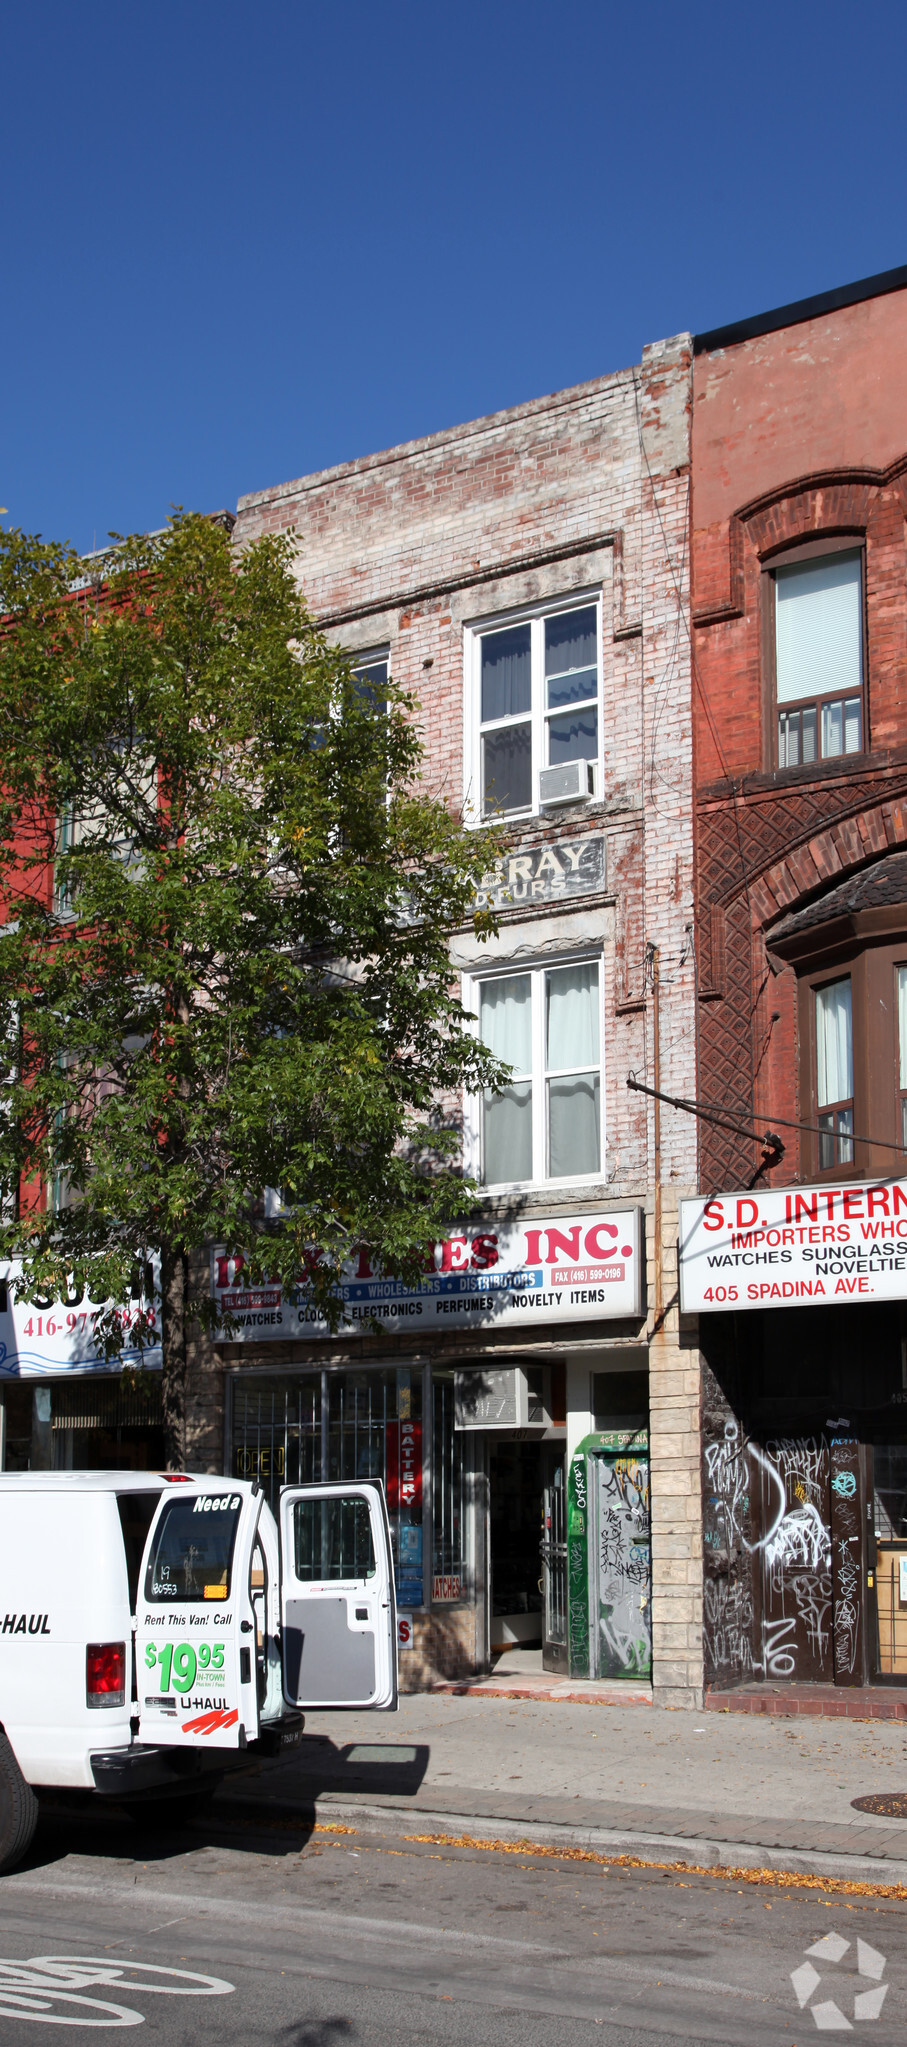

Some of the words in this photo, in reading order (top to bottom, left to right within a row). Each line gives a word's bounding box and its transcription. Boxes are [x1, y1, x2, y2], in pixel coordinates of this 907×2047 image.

[498, 879, 566, 903] FURS
[703, 1199, 768, 1231] S.D.
[524, 1223, 633, 1266] INC.
[731, 1224, 851, 1249] IMPORTERS
[860, 1219, 907, 1240] WHO
[707, 1250, 792, 1268] WATCHES
[802, 1241, 907, 1261] SUNGLASS
[816, 1257, 906, 1275] NOVELTIE
[368, 1280, 441, 1298] WHOLESALERS
[460, 1272, 536, 1291] DISTRIBUTORS
[555, 1272, 569, 1283] FAX
[570, 1269, 588, 1284] (416)
[590, 1267, 621, 1281] 599-0196
[703, 1285, 739, 1302] 405
[747, 1279, 826, 1300] SPADINA
[834, 1276, 875, 1295] AVE.
[238, 1312, 283, 1327] WATCHES
[352, 1302, 423, 1319] ELECTRONICS
[436, 1297, 494, 1314] PERFUMES
[512, 1292, 563, 1308] NOVELTY
[571, 1289, 605, 1304] ITEMS
[240, 1450, 281, 1473] OPEN
[402, 1424, 416, 1505] BATTERY
[193, 1494, 232, 1513] Need
[230, 1496, 240, 1510] a
[432, 1576, 460, 1600] ATCHES
[145, 1614, 165, 1626] Rent
[168, 1614, 186, 1626] This
[189, 1614, 210, 1626] Van!
[213, 1613, 233, 1625] Call
[197, 1673, 226, 1682] IN-TOWN
